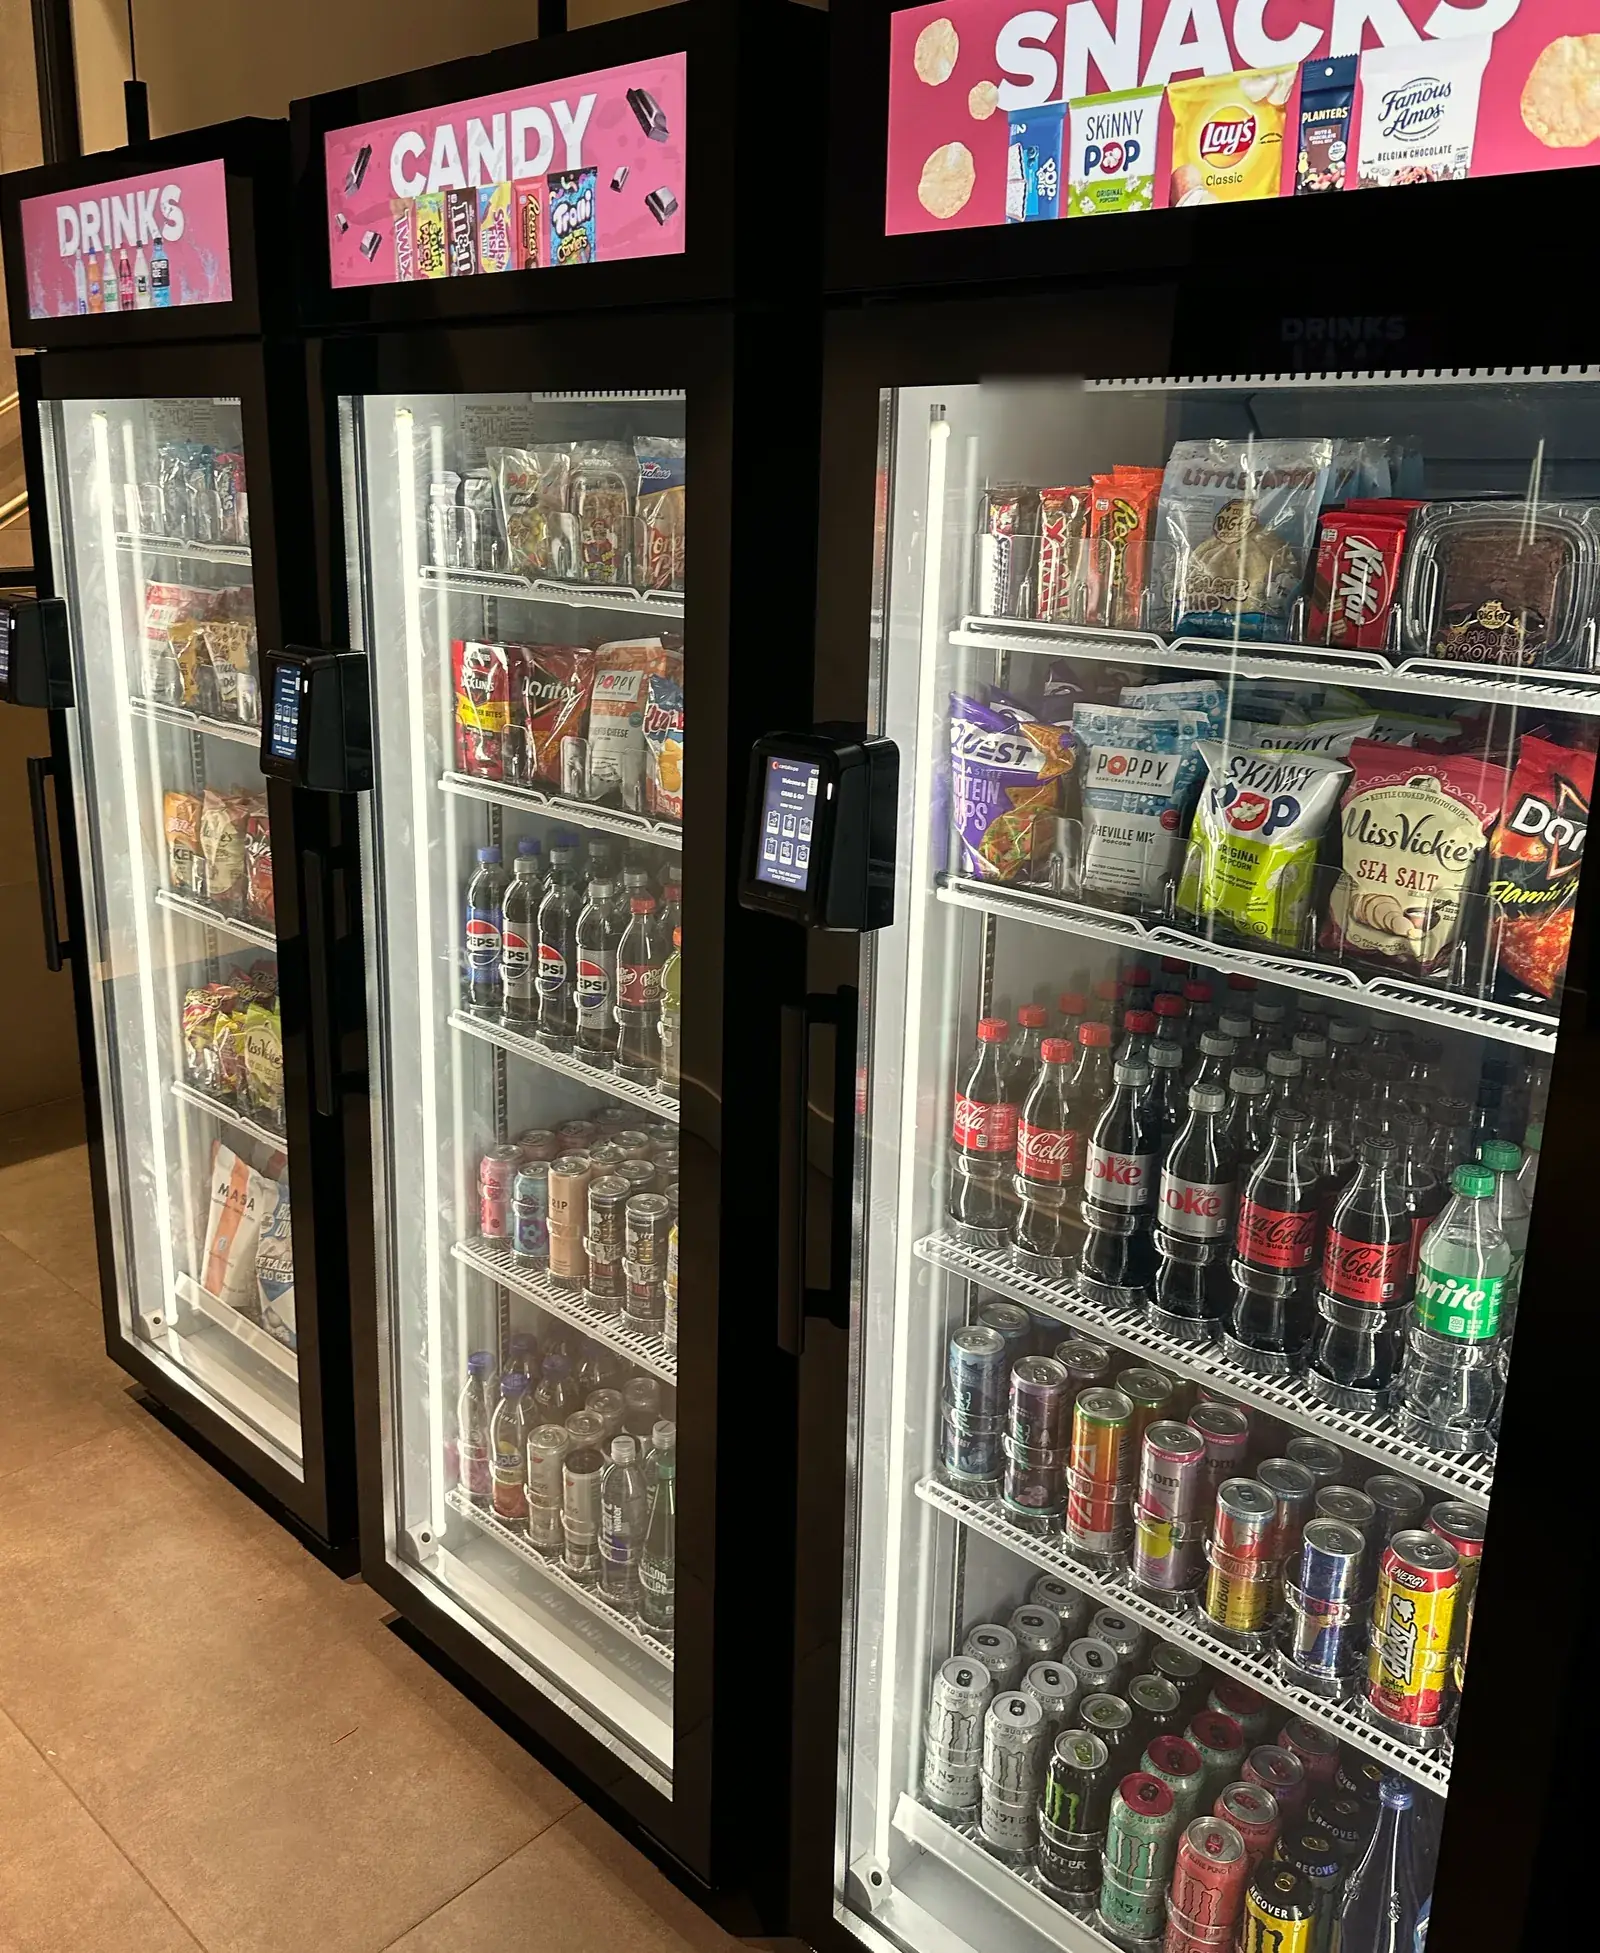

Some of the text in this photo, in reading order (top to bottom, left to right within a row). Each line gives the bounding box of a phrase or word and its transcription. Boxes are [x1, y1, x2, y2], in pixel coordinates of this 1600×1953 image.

[1378, 81, 1452, 122] Famous
[1301, 106, 1348, 124] PLANTERS
[1383, 104, 1444, 137] Amos
[390, 93, 598, 198] CANDY
[1202, 120, 1254, 155] Lay's
[1084, 140, 1141, 176] POP
[1377, 145, 1452, 162] BELGIAN CHOCOLATE
[1205, 172, 1243, 186] Classic
[56, 184, 185, 257] DRINKS
[553, 188, 592, 237] Trolli
[596, 675, 636, 691] POPPY
[606, 727, 629, 739] CHEESE
[1096, 752, 1171, 781] POPPY
[1210, 778, 1301, 837] POP
[1370, 790, 1467, 820] KETTLE COOKED POTATO CHIPS
[1135, 830, 1156, 844] MIX
[1342, 807, 1486, 872] Miss Vickie's
[1356, 859, 1440, 892] SEA SALT
[506, 949, 530, 963] PSI
[542, 963, 564, 975] PSI
[580, 978, 608, 991] EPSI
[1035, 1156, 1056, 1165] TASTE
[217, 1182, 256, 1212] MASA
[552, 1198, 568, 1210] RIP
[1341, 1271, 1371, 1285] SUGAR
[1416, 1272, 1486, 1312] prite
[1147, 1468, 1180, 1488] oom
[613, 1505, 622, 1532] water
[1390, 1565, 1428, 1588] ENERGY
[1381, 1601, 1418, 1686] GHOST
[1337, 1768, 1357, 1794] COVER
[984, 1803, 1036, 1826] ONSTER
[1315, 1816, 1360, 1841] RECOVER
[1043, 1843, 1087, 1871] NSTER
[1295, 1861, 1339, 1876] RECOVER
[1249, 1885, 1289, 1920] RECOVER
